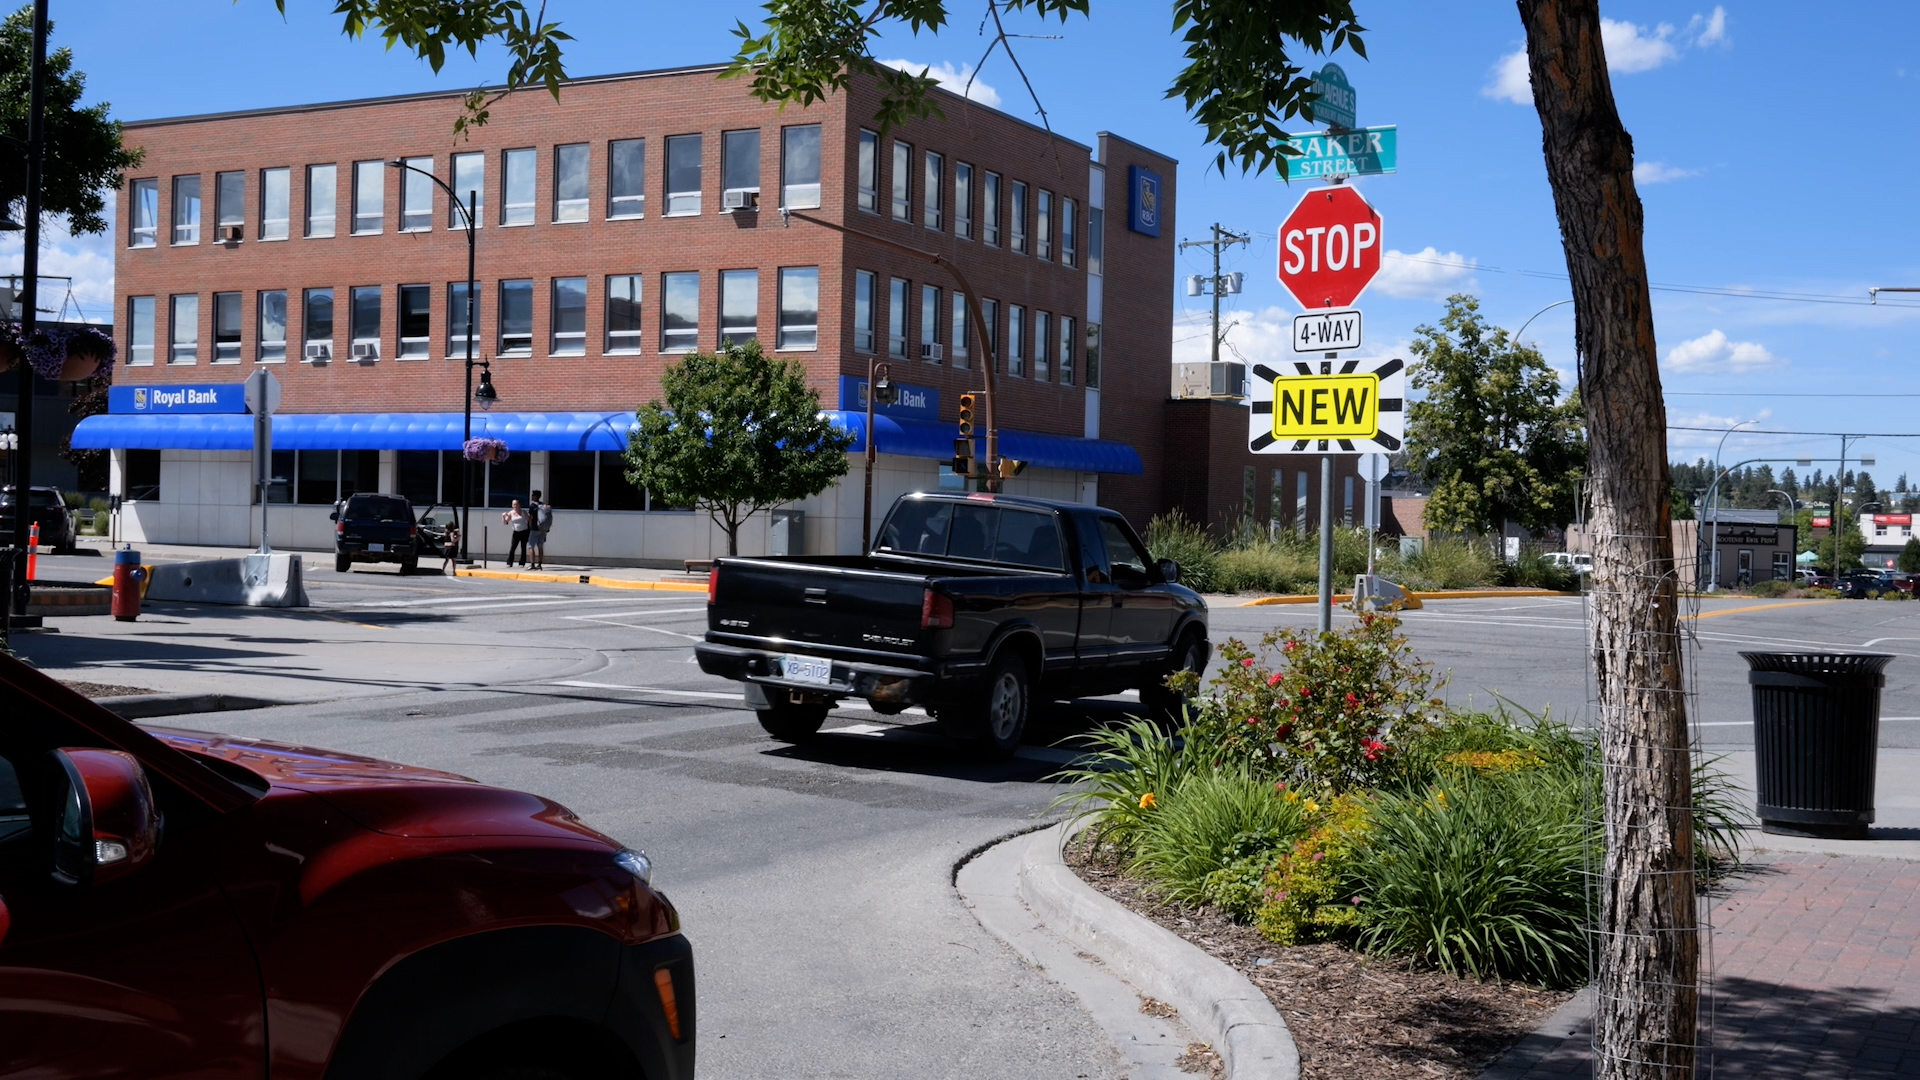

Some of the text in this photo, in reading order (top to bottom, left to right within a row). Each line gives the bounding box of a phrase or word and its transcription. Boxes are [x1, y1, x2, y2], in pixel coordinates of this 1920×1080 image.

[1325, 83, 1349, 110] AVENUE
[1350, 93, 1354, 112] S
[1287, 132, 1384, 160] BAKER
[1301, 157, 1368, 176] STREET
[1283, 222, 1377, 275] STOP
[1300, 319, 1354, 344] 4-WAY
[154, 388, 217, 408] Royal Bank
[904, 390, 926, 408] Bank
[1281, 387, 1369, 426] NEW
[863, 634, 915, 646] CHEVROLET
[786, 661, 829, 680] XB-5102
